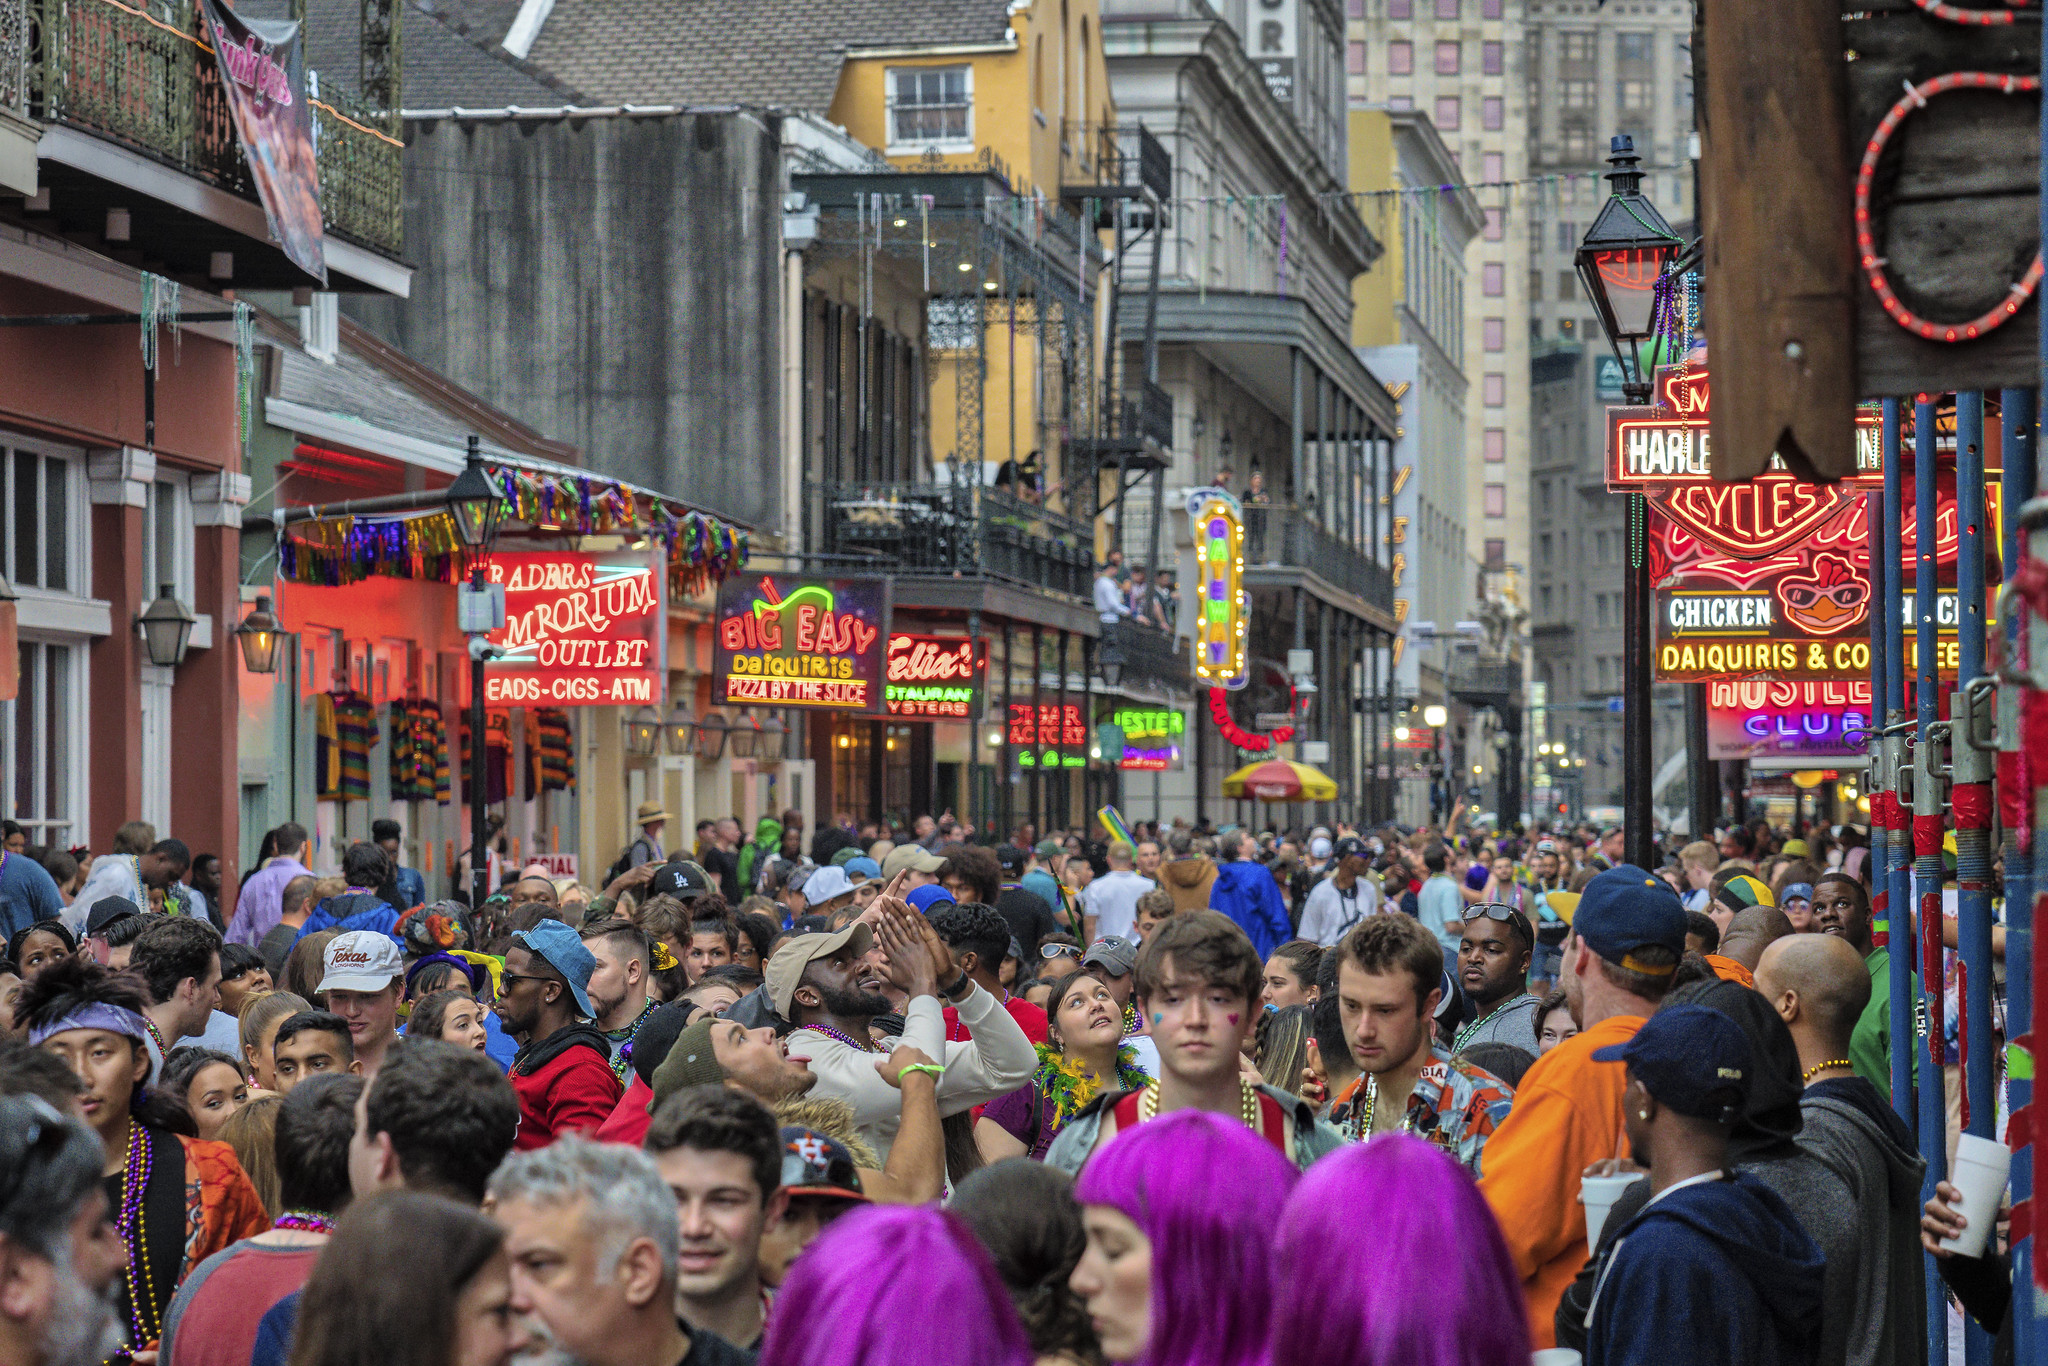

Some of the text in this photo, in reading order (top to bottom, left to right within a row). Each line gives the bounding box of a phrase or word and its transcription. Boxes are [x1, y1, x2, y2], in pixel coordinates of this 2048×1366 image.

[1629, 429, 1711, 475] HARLE
[1685, 482, 1818, 538] CYCLES
[489, 562, 593, 592] RADERS
[502, 571, 657, 649] MPORIUM
[1669, 597, 1773, 628] CHICKEN
[720, 604, 878, 655] BIG EASY
[538, 639, 649, 667] OUTLET
[1662, 643, 1800, 673] DAIQUIRIS
[1807, 643, 1830, 670] &
[486, 676, 651, 701] EADS-CIGS-ATM
[727, 677, 868, 704] PIZZA BY THE SLICE
[1711, 681, 1872, 710] HUSTLE
[886, 700, 968, 716] YSTERS
[1009, 726, 1087, 745] ACTORY
[1744, 712, 1864, 738] CLUB
[330, 946, 372, 966] Texas
[1421, 1065, 1448, 1079] GIA
